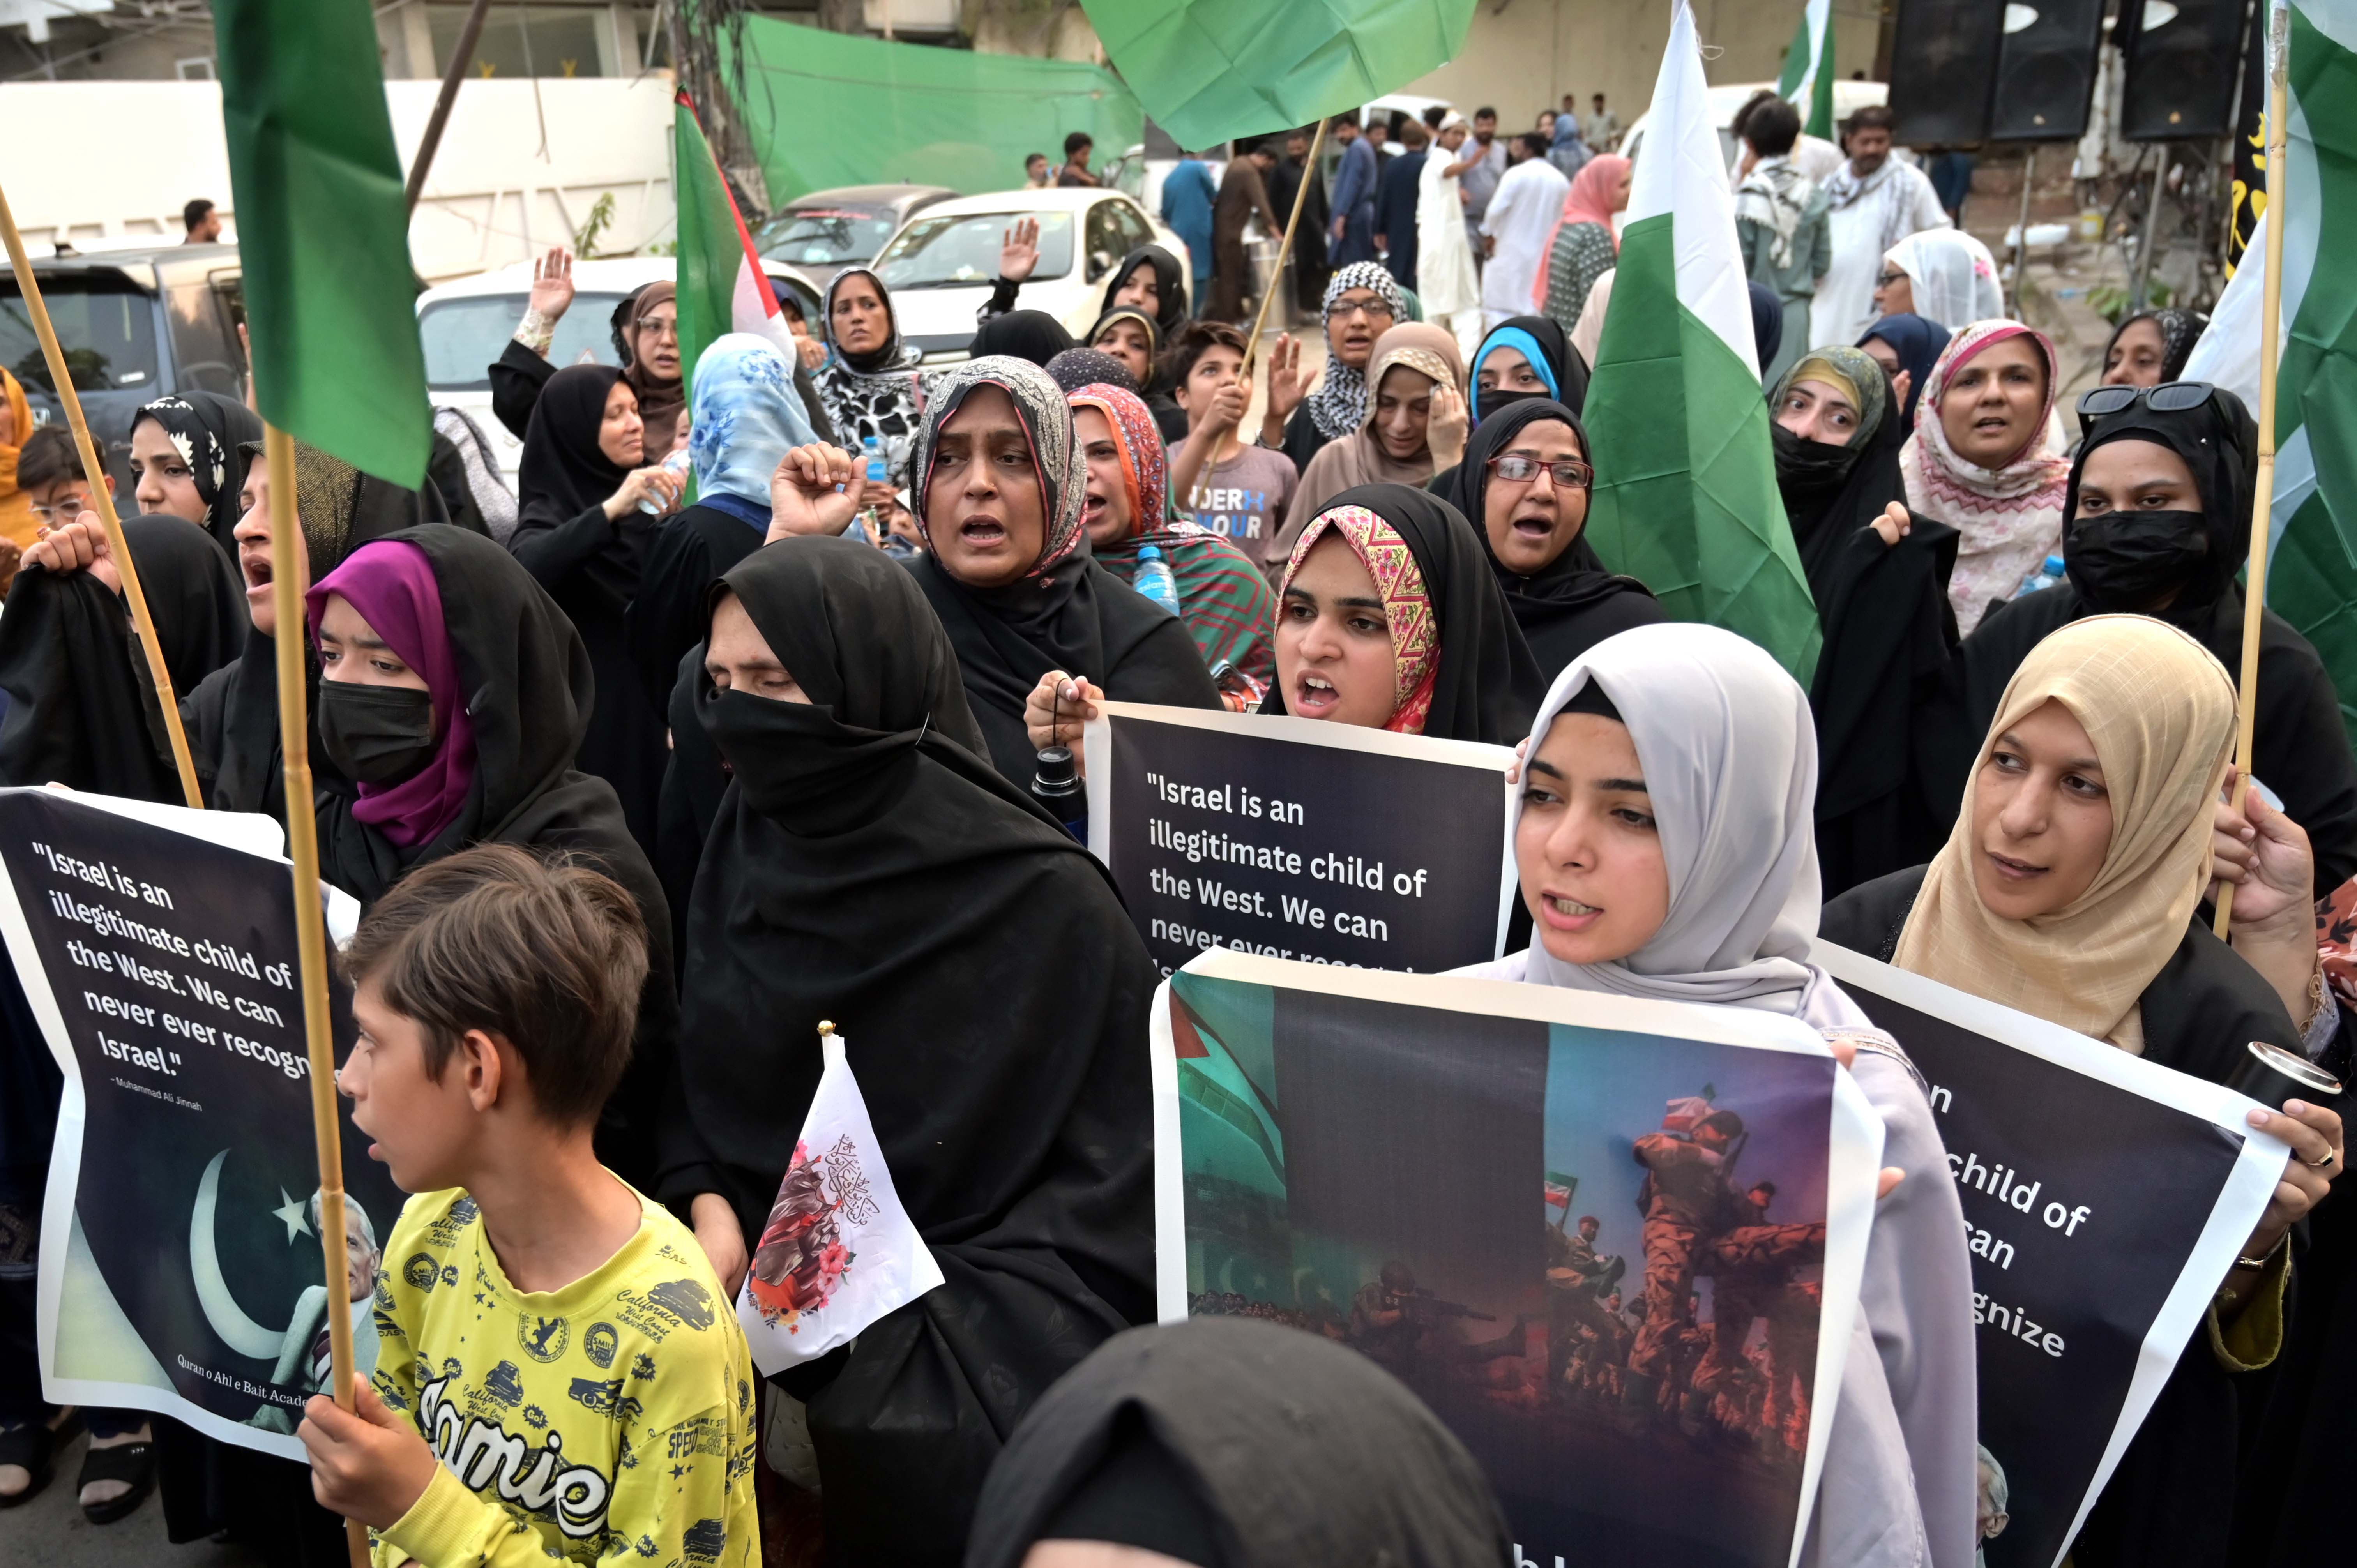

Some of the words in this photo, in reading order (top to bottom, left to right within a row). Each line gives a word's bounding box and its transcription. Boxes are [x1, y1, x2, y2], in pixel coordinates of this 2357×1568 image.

[1147, 773, 1232, 813] "Israel
[1241, 787, 1262, 818] is
[1270, 800, 1303, 825] an
[32, 842, 115, 891] "Israel
[112, 866, 138, 898] is
[140, 882, 174, 910] an
[1150, 818, 1302, 875] illegitimate
[1310, 853, 1383, 891] child
[1393, 869, 1427, 898] of
[1150, 868, 1191, 900] the
[1197, 878, 1272, 918] West.
[1281, 895, 1325, 929] We
[1334, 913, 1387, 941] can
[49, 890, 191, 957] illegitimate
[194, 939, 261, 980] child
[265, 963, 293, 990] of
[1152, 918, 1223, 951] never
[67, 940, 113, 972] the
[113, 951, 187, 996] West.
[184, 975, 230, 1010] We
[234, 997, 284, 1028] can
[84, 991, 155, 1027] never
[163, 1013, 216, 1045] ever
[98, 1031, 181, 1076] Israel."
[116, 1077, 162, 1099] Muhammad
[163, 1092, 174, 1103] Ali
[176, 1096, 202, 1112] Jinnah
[1930, 1083, 1952, 1114] n
[1946, 1152, 2041, 1213] child
[2043, 1202, 2091, 1237] of
[617, 1289, 681, 1327] California
[626, 1306, 644, 1320] West
[643, 1317, 670, 1336] Coast
[1972, 1290, 2065, 1357] gnize
[593, 1337, 614, 1351] SMILE
[178, 1354, 204, 1376] Quran
[207, 1370, 212, 1379] o
[214, 1372, 232, 1387] Ahl
[235, 1381, 240, 1390] e
[243, 1381, 267, 1398] Bait
[269, 1390, 308, 1407] Acade
[446, 1361, 459, 1374] Go!
[463, 1384, 508, 1413] California
[468, 1400, 488, 1414] West
[527, 1409, 544, 1425] Go!
[638, 1538, 652, 1553] Go!
